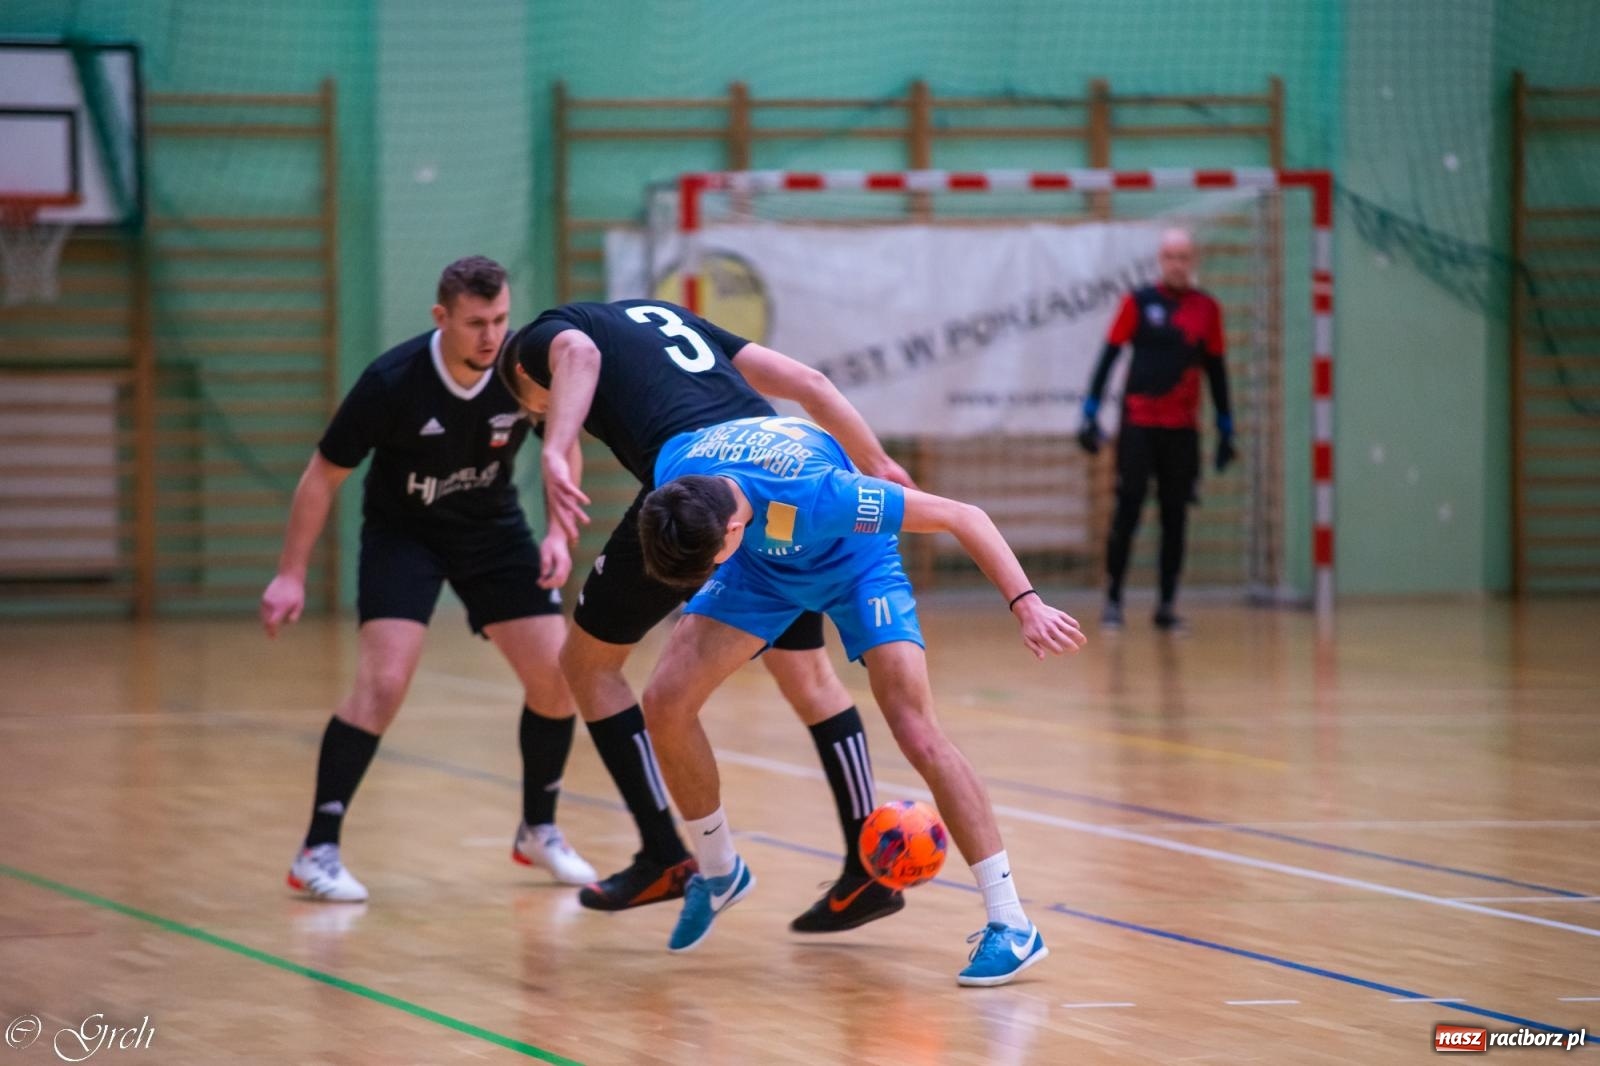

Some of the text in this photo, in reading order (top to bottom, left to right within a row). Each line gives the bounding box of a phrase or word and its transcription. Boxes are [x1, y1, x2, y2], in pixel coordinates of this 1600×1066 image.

[625, 305, 716, 373] 3
[897, 333, 935, 367] W
[735, 429, 777, 447] 931
[747, 445, 805, 480] FIRMA
[856, 486, 881, 522] LOFT
